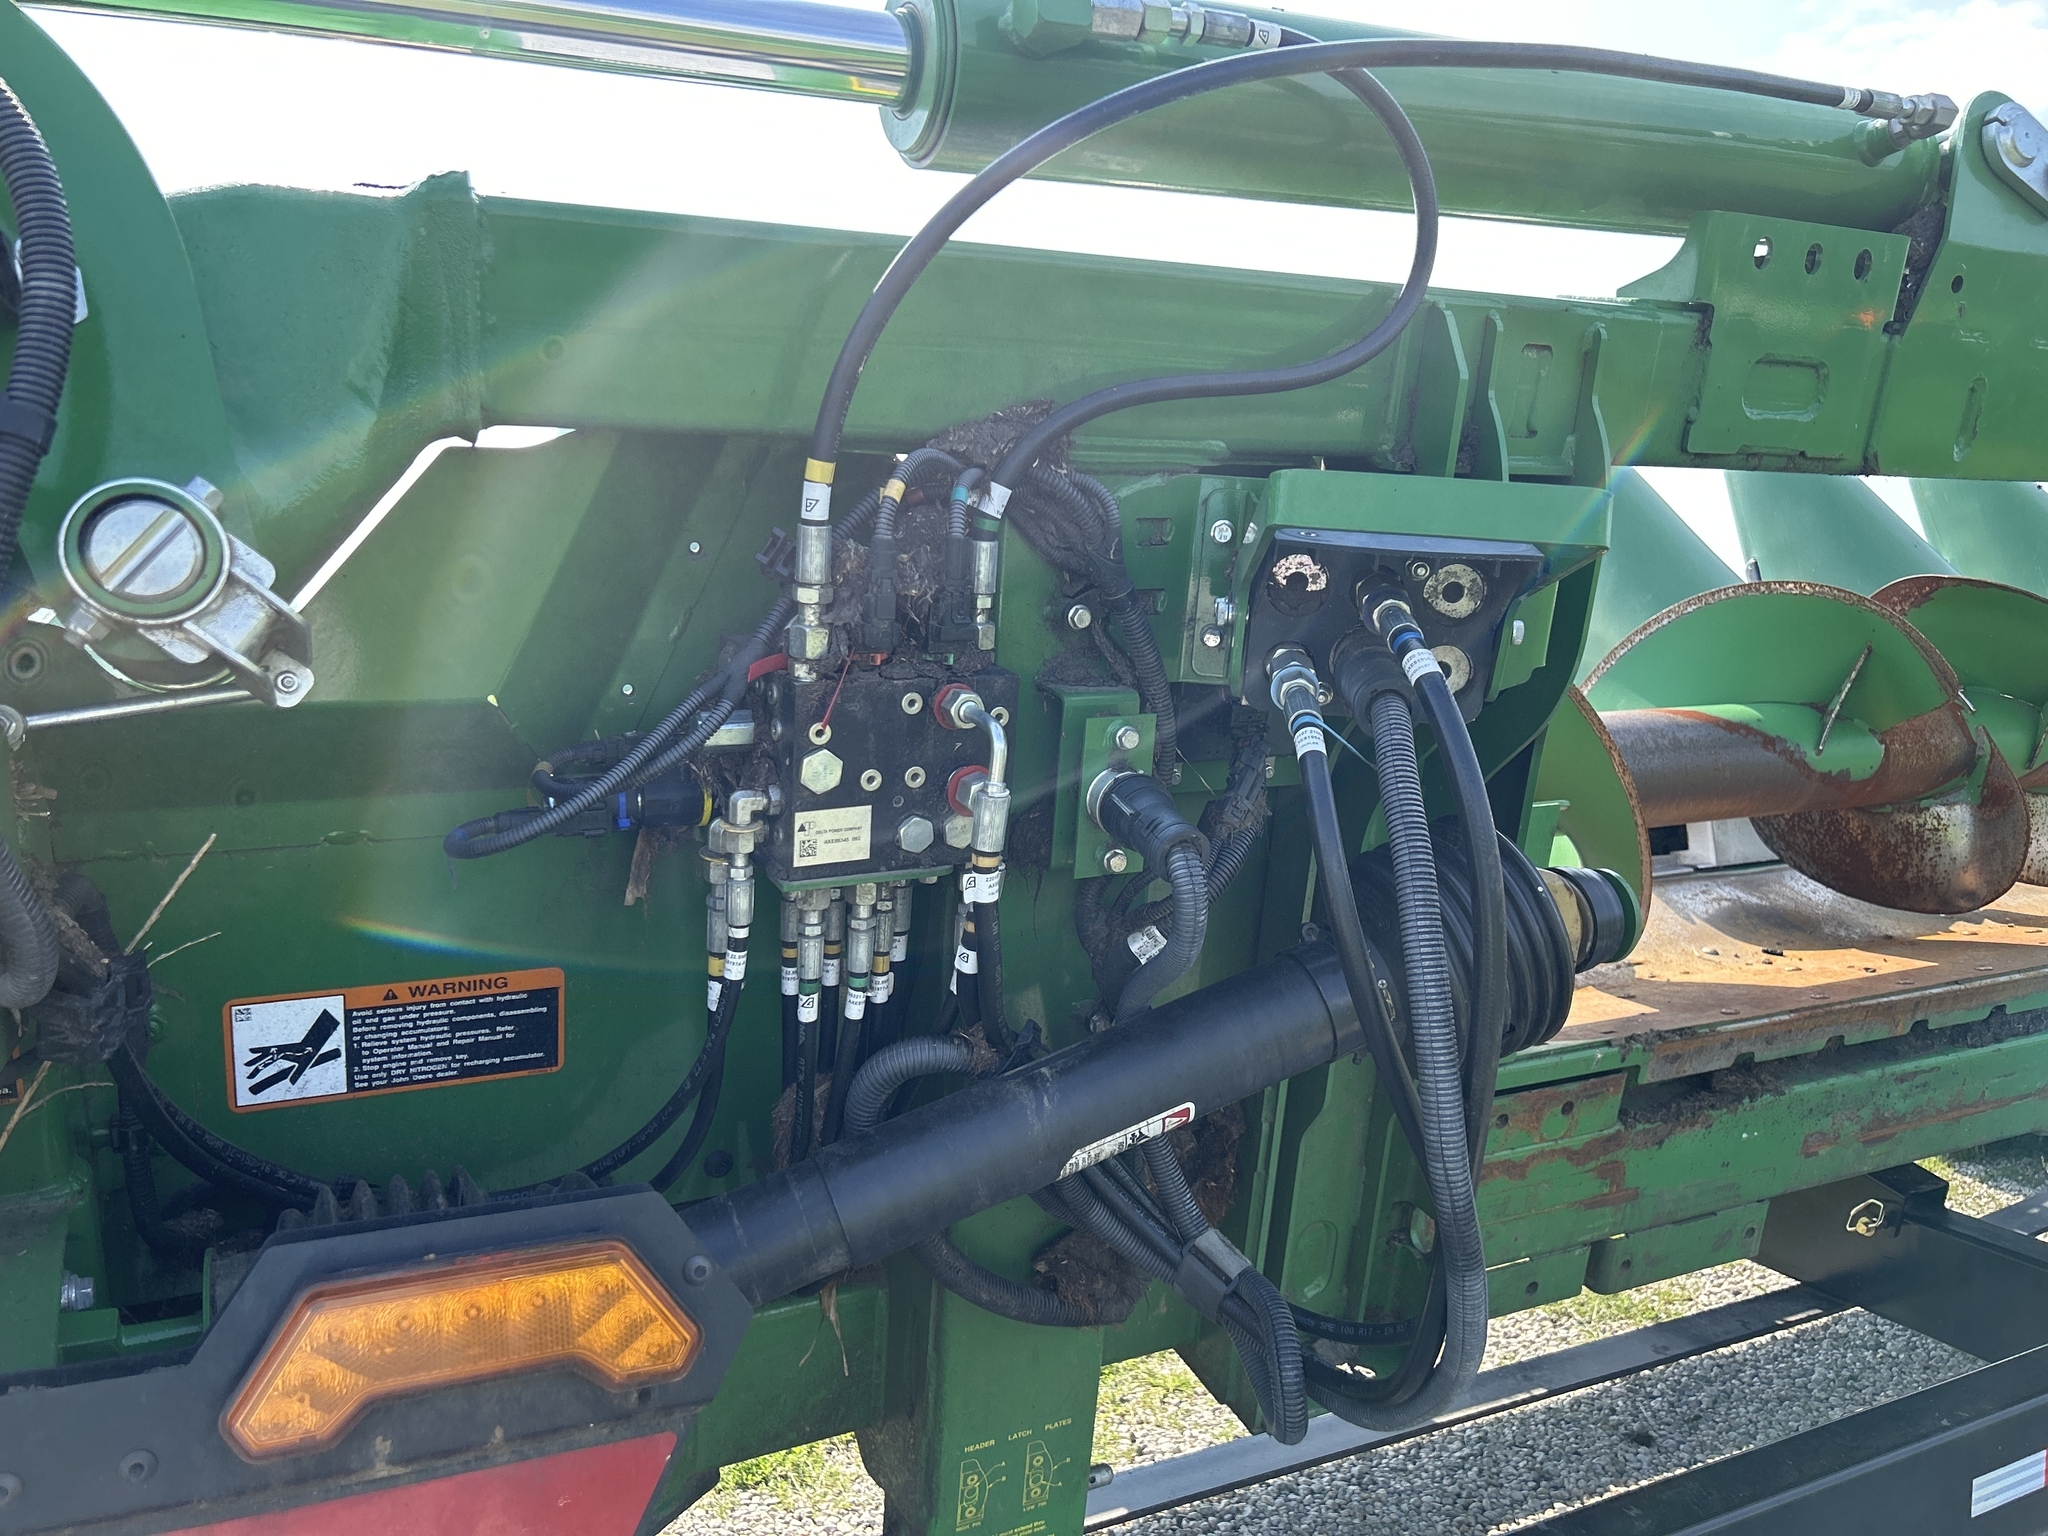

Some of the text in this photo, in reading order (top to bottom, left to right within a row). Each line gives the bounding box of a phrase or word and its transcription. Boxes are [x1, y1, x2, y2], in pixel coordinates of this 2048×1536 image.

[408, 976, 508, 998] WARNING
[496, 993, 528, 1002] hydraulic
[380, 1021, 413, 1030] removing
[416, 1018, 449, 1026] hydraulic
[499, 1007, 548, 1017] disassembling
[364, 1032, 398, 1040] changing
[420, 1033, 452, 1042] hydraulic
[372, 1046, 404, 1055] Operator
[362, 1056, 388, 1064] system
[409, 1064, 447, 1074] NITROGEN
[464, 1058, 500, 1067] recharging
[964, 1418, 1072, 1453] HEADER LATCH PLATES
